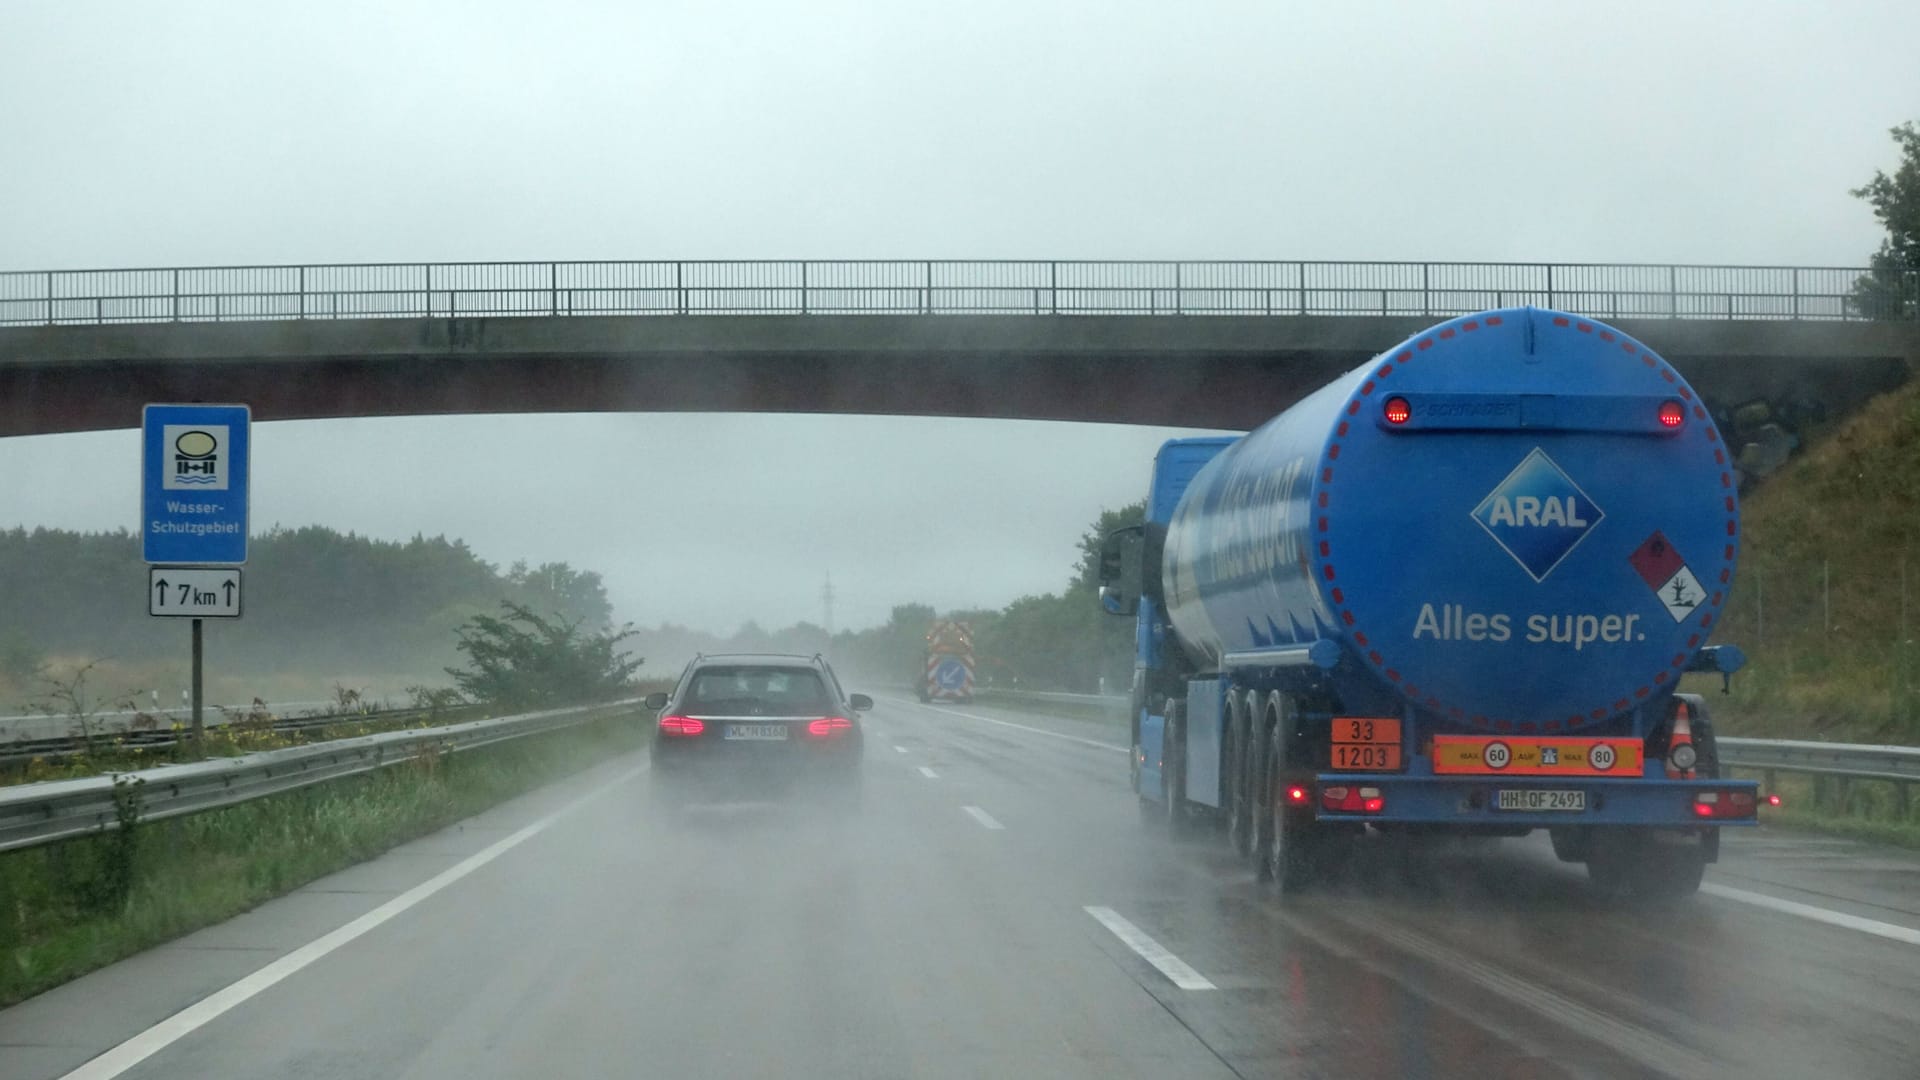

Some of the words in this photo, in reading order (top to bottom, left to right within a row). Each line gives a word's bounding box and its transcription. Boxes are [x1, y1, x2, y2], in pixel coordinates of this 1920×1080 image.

[167, 501, 225, 514] Wasser-
[1489, 495, 1587, 528] ARAL
[151, 520, 239, 536] Schutzgebiet
[178, 584, 191, 605] 7
[193, 587, 216, 605] km
[1412, 602, 1511, 642] Alles
[1526, 612, 1645, 651] super.
[1351, 720, 1374, 741] 33
[1338, 747, 1387, 767] 1203
[1489, 749, 1505, 762] 60
[1595, 751, 1611, 763] 80
